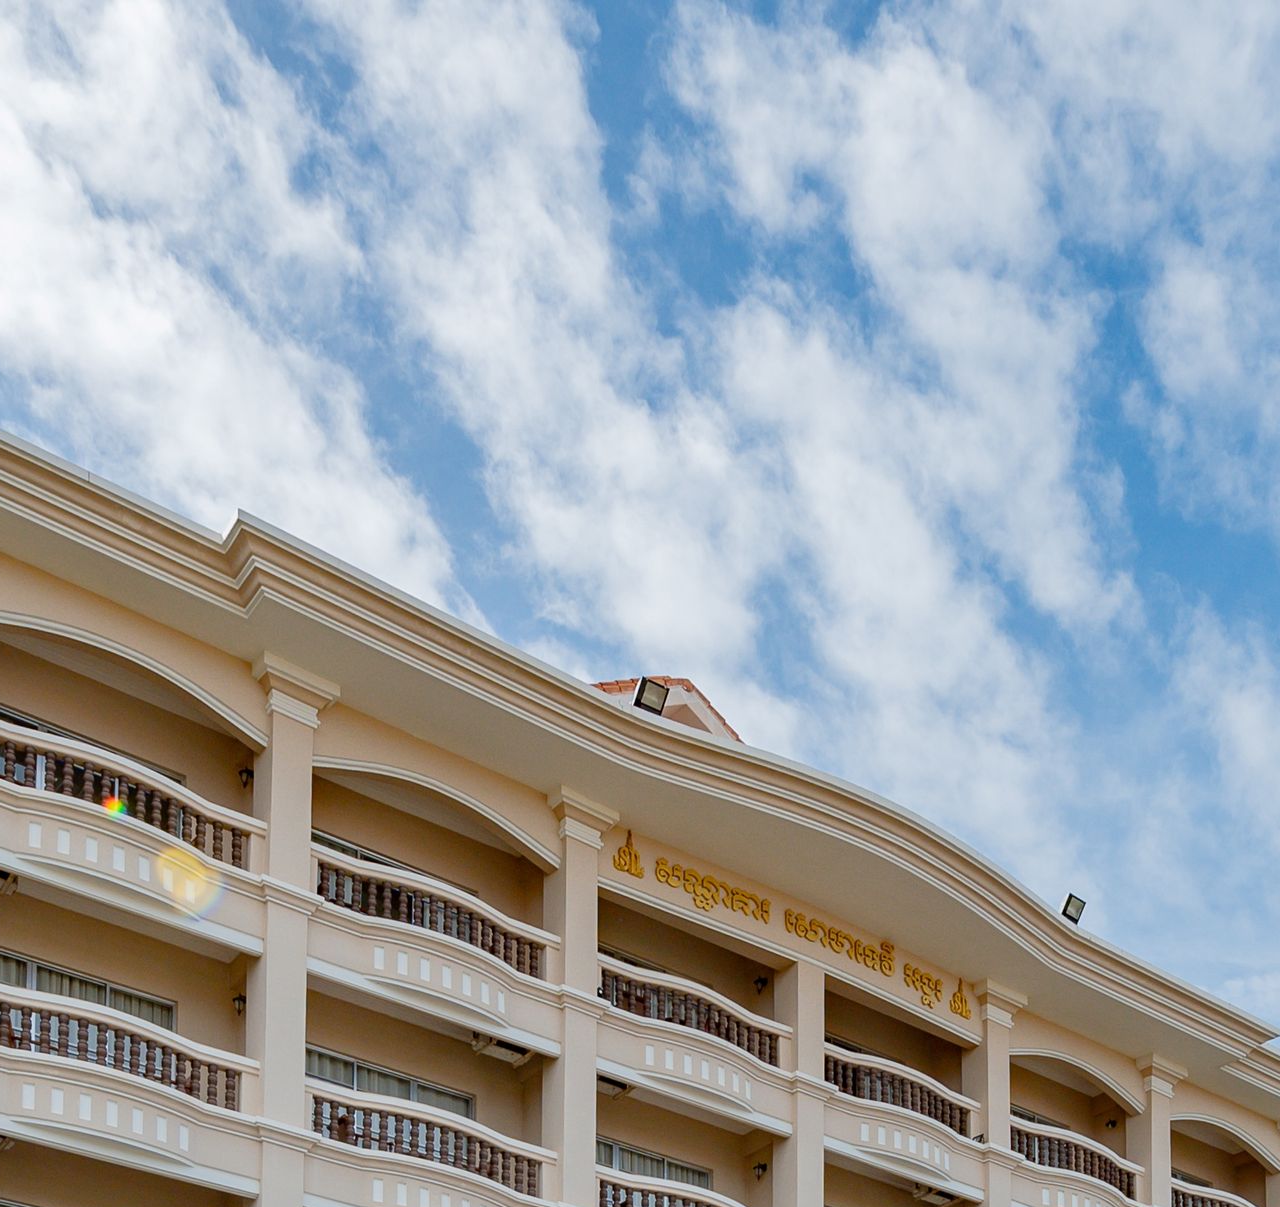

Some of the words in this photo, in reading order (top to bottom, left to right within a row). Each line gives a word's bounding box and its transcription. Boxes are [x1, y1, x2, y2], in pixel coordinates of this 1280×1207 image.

[654, 856, 772, 925] សណ្ឋាគារ
[784, 907, 897, 978] សោមាទេវី
[903, 962, 944, 1010] អង្គរ
